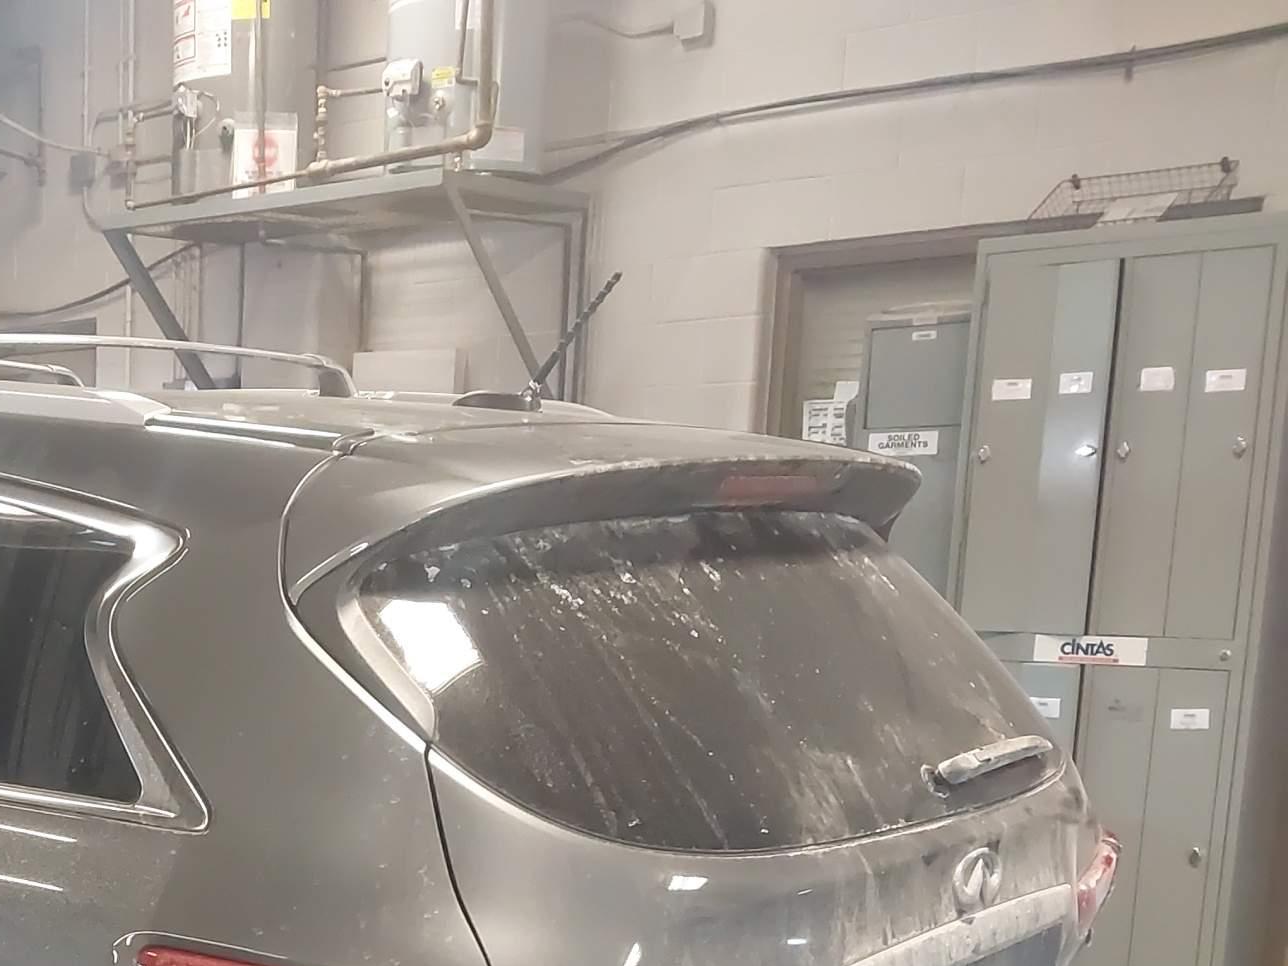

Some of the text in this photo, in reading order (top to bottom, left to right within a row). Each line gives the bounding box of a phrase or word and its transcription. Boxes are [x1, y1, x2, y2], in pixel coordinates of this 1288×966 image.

[887, 433, 920, 442] SOILED
[878, 440, 929, 450] GARMENTS
[1060, 638, 1114, 656] CINTAS
